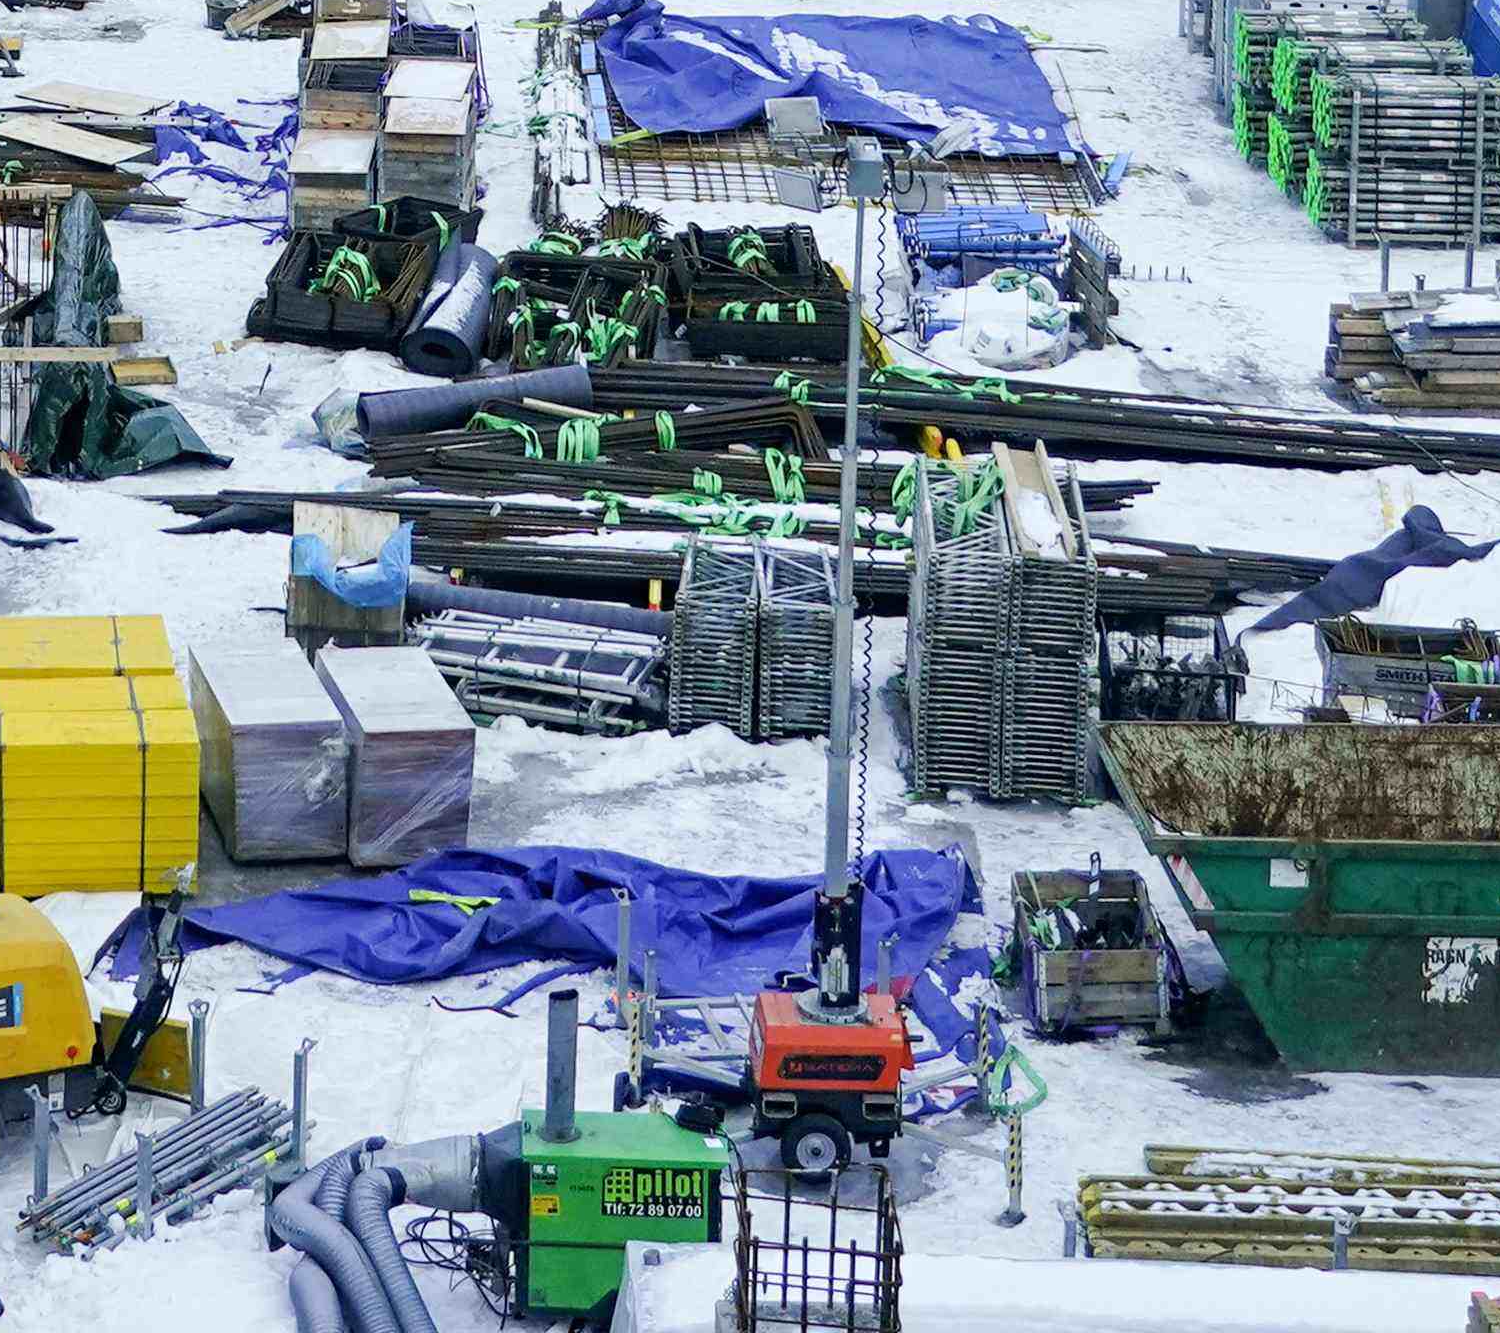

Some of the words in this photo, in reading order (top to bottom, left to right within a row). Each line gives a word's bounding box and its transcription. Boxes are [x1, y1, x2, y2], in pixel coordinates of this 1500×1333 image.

[1375, 668, 1424, 682] SMITH
[636, 1169, 702, 1203] pilot
[604, 1203, 627, 1215] Tlf:
[629, 1204, 645, 1216] 72
[647, 1204, 665, 1217] 89
[667, 1205, 682, 1217] 07
[685, 1205, 702, 1217] 00
